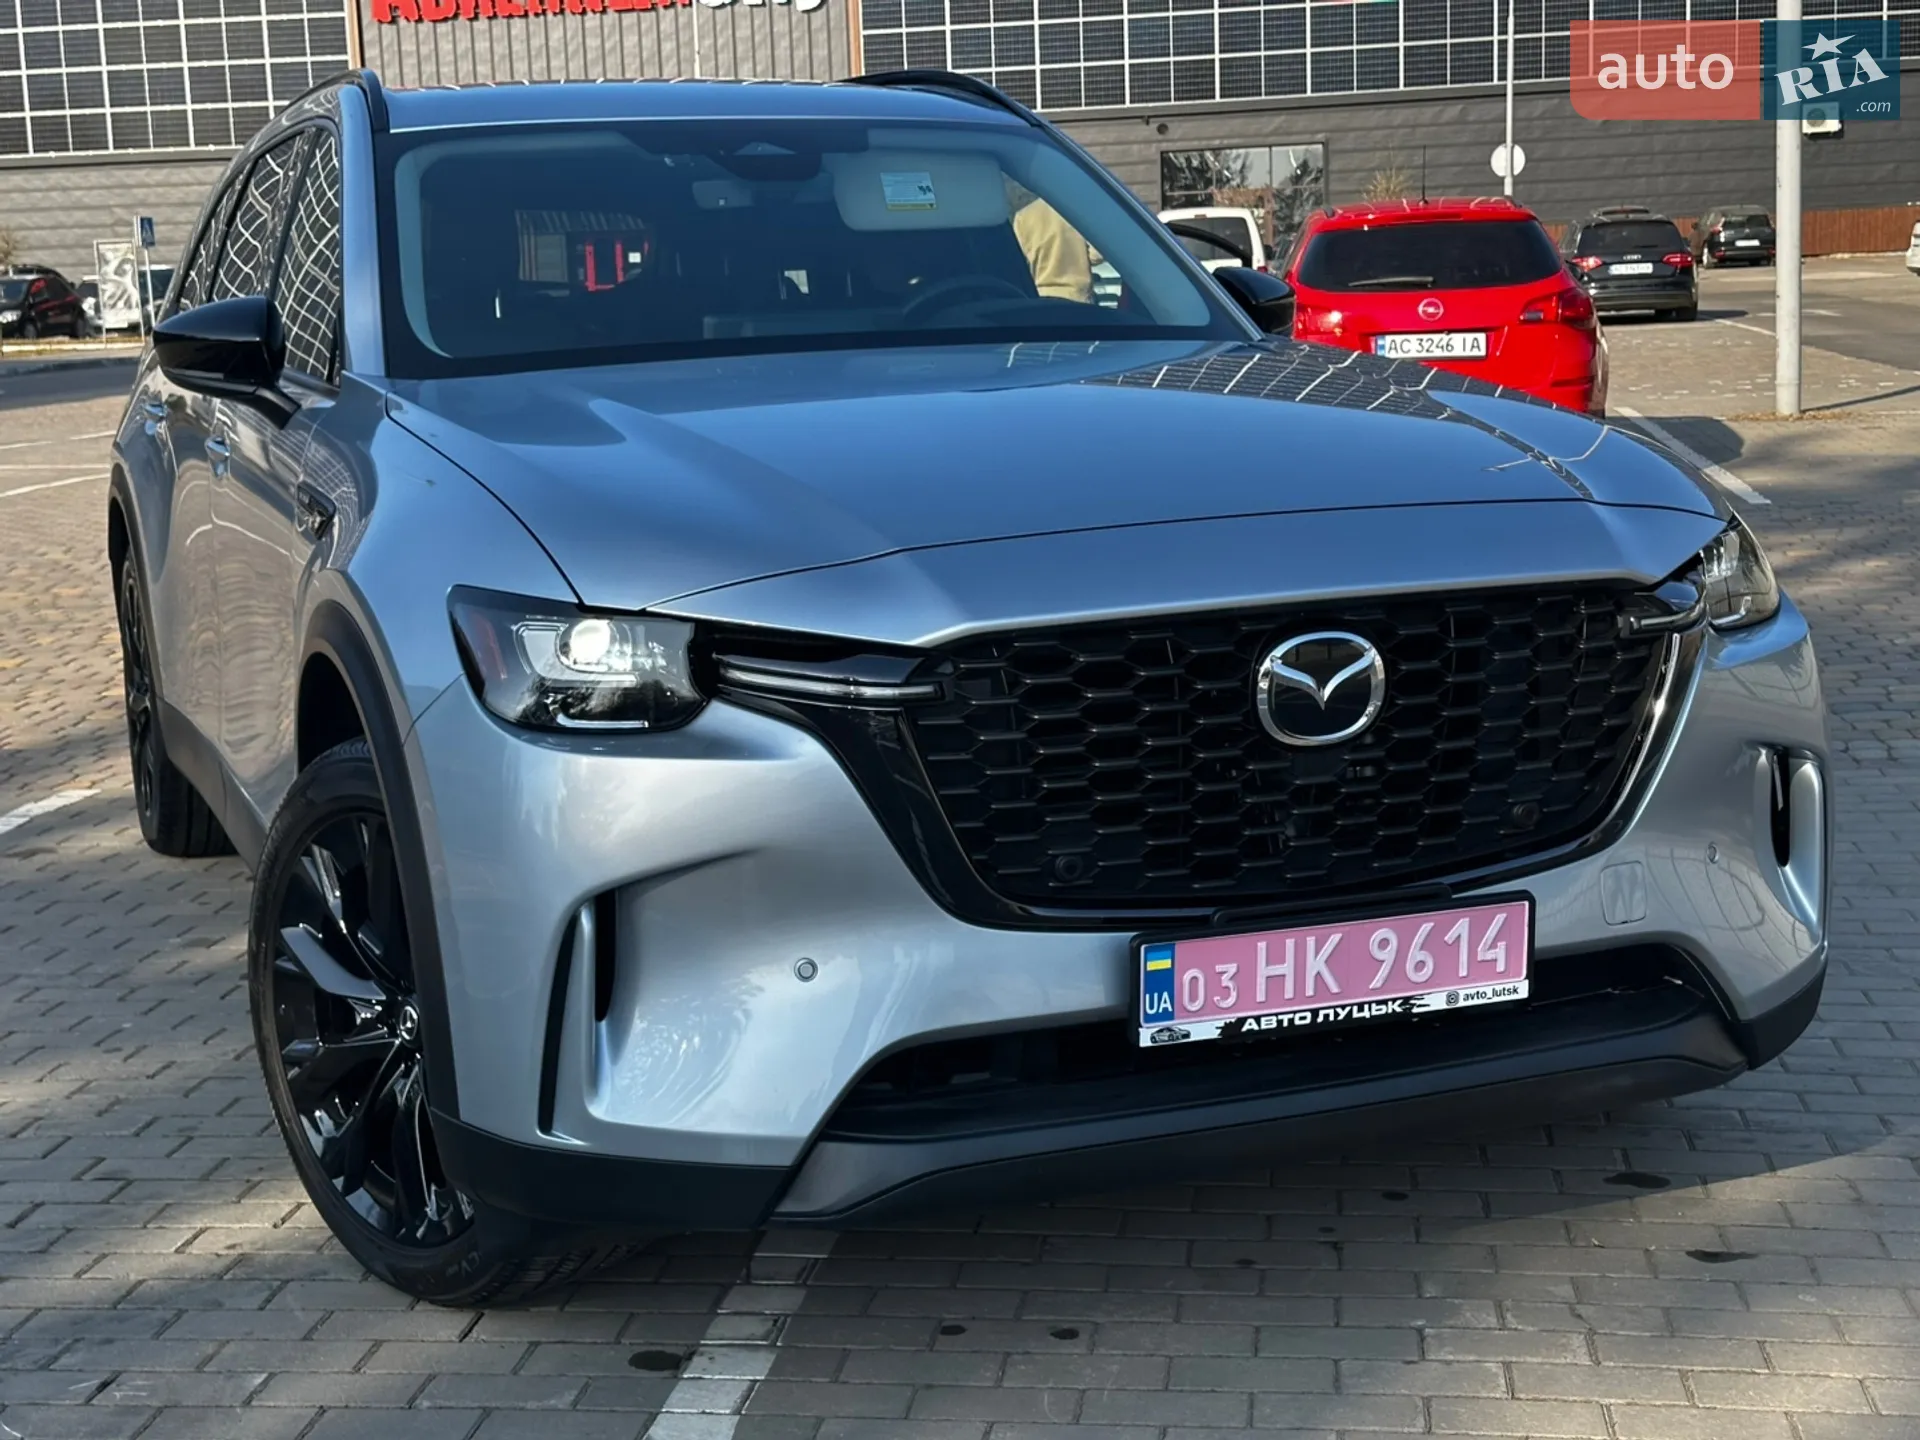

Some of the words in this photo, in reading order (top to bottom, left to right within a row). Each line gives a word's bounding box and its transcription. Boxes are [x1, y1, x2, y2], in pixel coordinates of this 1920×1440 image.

[1387, 338, 1412, 354] AC
[1415, 337, 1455, 354] 3246
[1462, 336, 1482, 353] IA
[1182, 962, 1239, 1012] 03
[1255, 933, 1343, 1003] HK
[1368, 912, 1508, 990] 9614
[1144, 990, 1173, 1015] UA
[1462, 984, 1520, 1003] avto_lutsk
[1240, 1010, 1312, 1033] АВТО
[1316, 999, 1405, 1024] ЛУЦЬК
